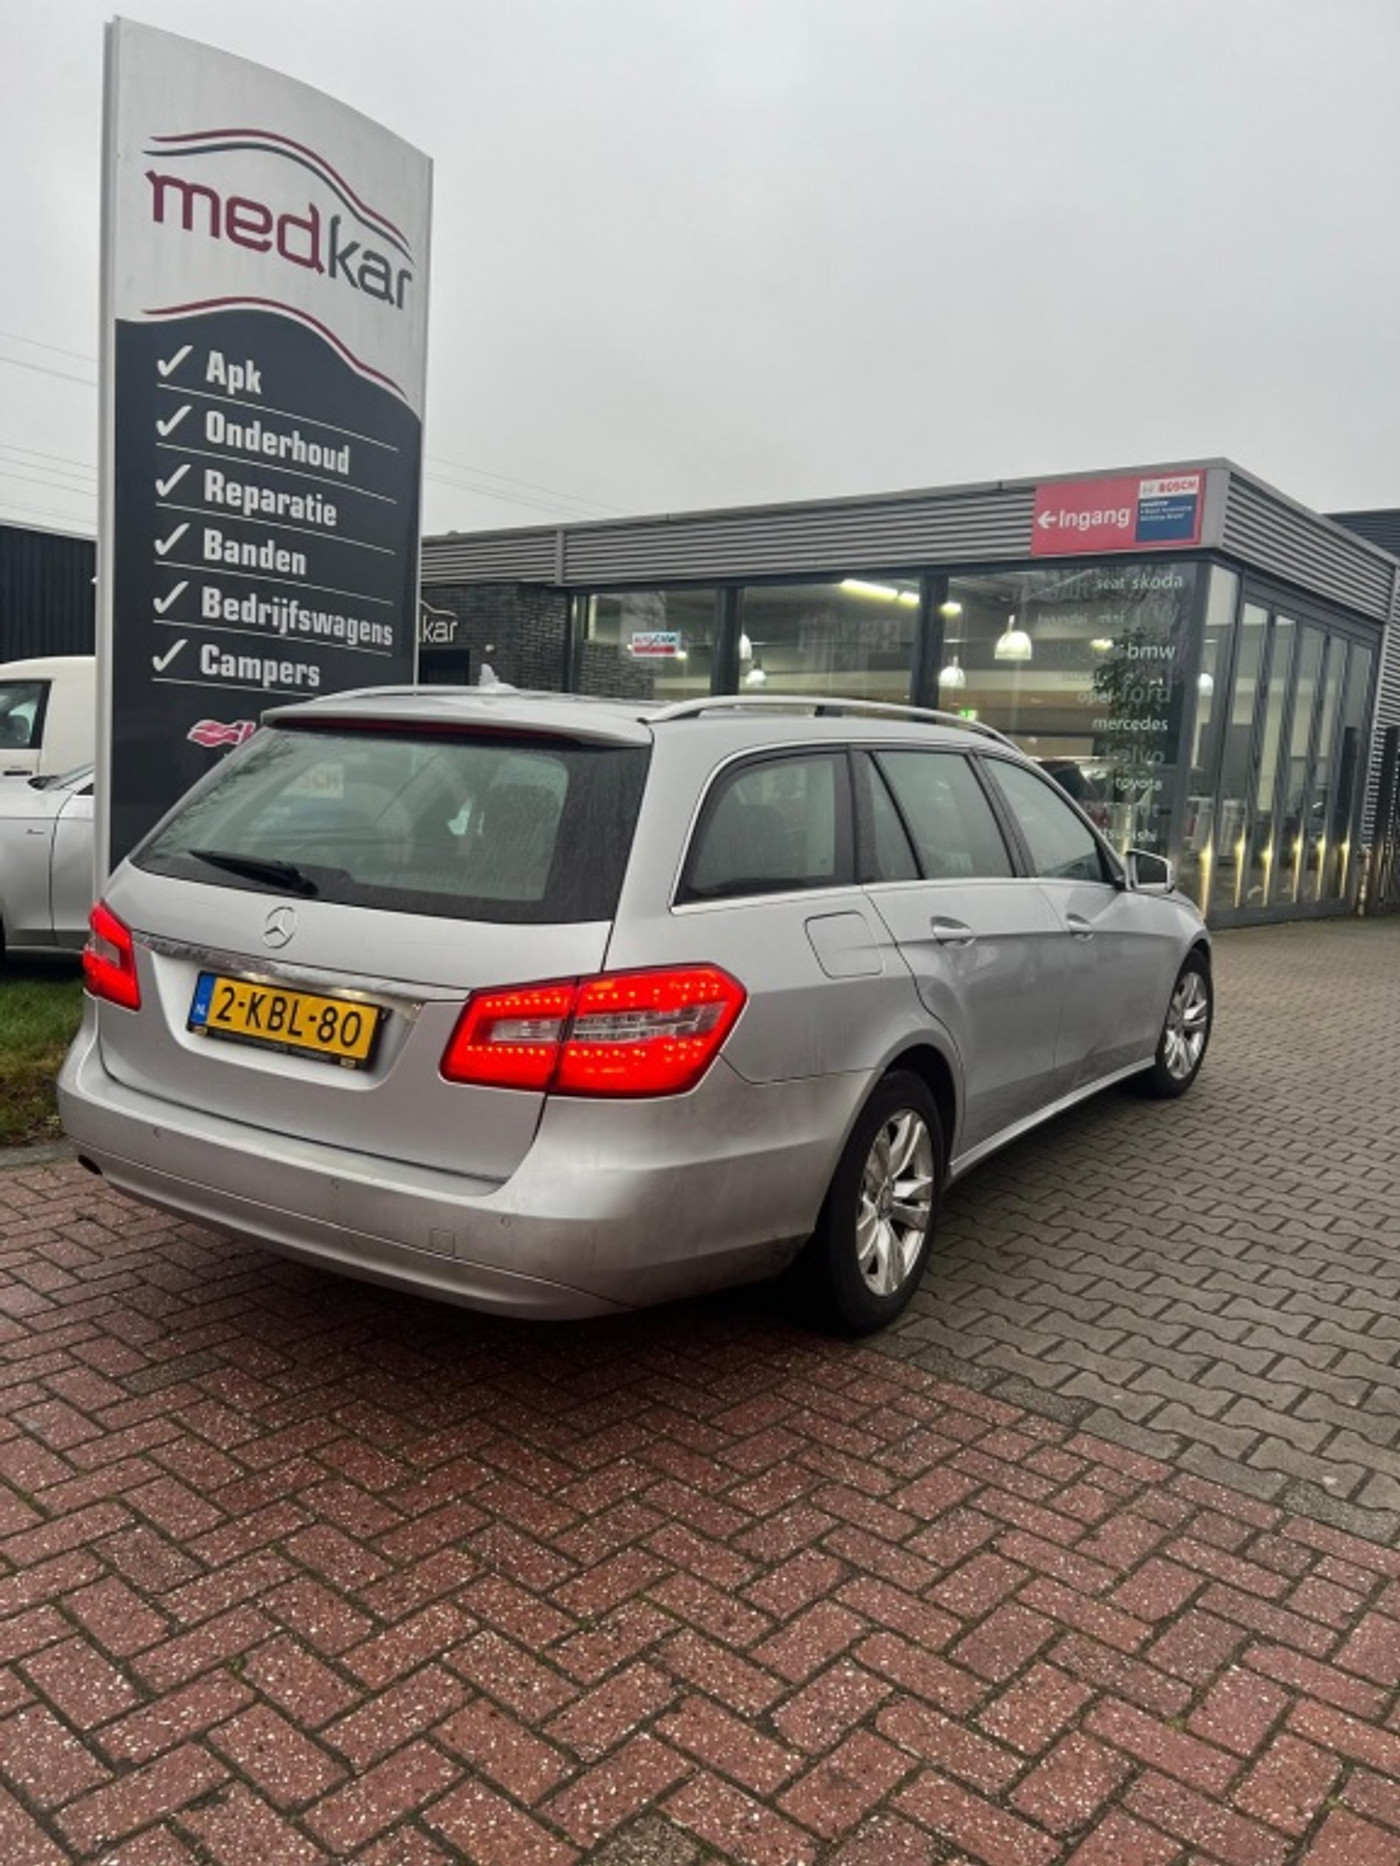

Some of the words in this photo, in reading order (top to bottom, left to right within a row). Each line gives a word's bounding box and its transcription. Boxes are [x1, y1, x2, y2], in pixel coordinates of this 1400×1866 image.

[144, 170, 412, 310] medkar
[206, 350, 262, 395] Apk
[206, 410, 350, 474] Onderhoud
[204, 469, 338, 527] Reparatie
[1059, 508, 1130, 531] Ingang
[203, 528, 307, 575] Banden
[1096, 577, 1125, 589] seat
[1131, 573, 1183, 589] skoda
[201, 586, 393, 646] Bedrijfswagens
[419, 616, 458, 643] kar
[200, 644, 321, 688] Campers
[1127, 643, 1176, 660] bmw
[1076, 688, 1113, 706] opel
[1121, 681, 1172, 704] ford
[1091, 716, 1169, 732] mercedes
[1115, 772, 1163, 792] toyota
[216, 986, 363, 1048] 2-KBL-80
